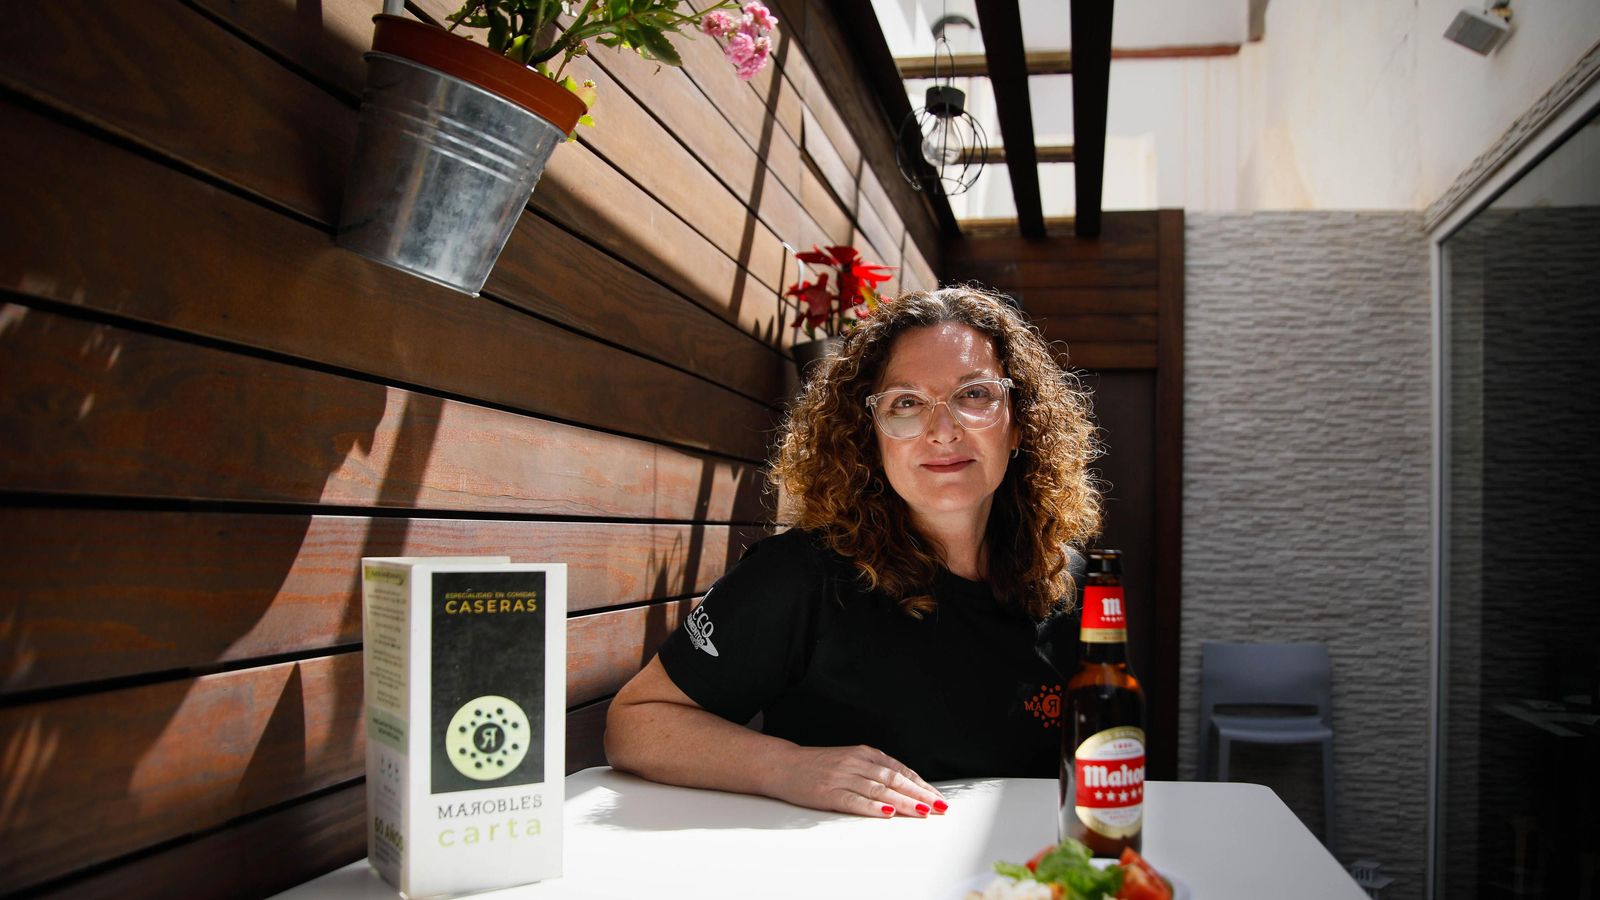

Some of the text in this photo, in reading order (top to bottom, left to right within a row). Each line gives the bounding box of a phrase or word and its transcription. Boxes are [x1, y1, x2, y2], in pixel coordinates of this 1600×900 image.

[445, 599, 537, 615] CASERAS
[692, 605, 714, 638] ECO
[437, 817, 541, 849] carta
